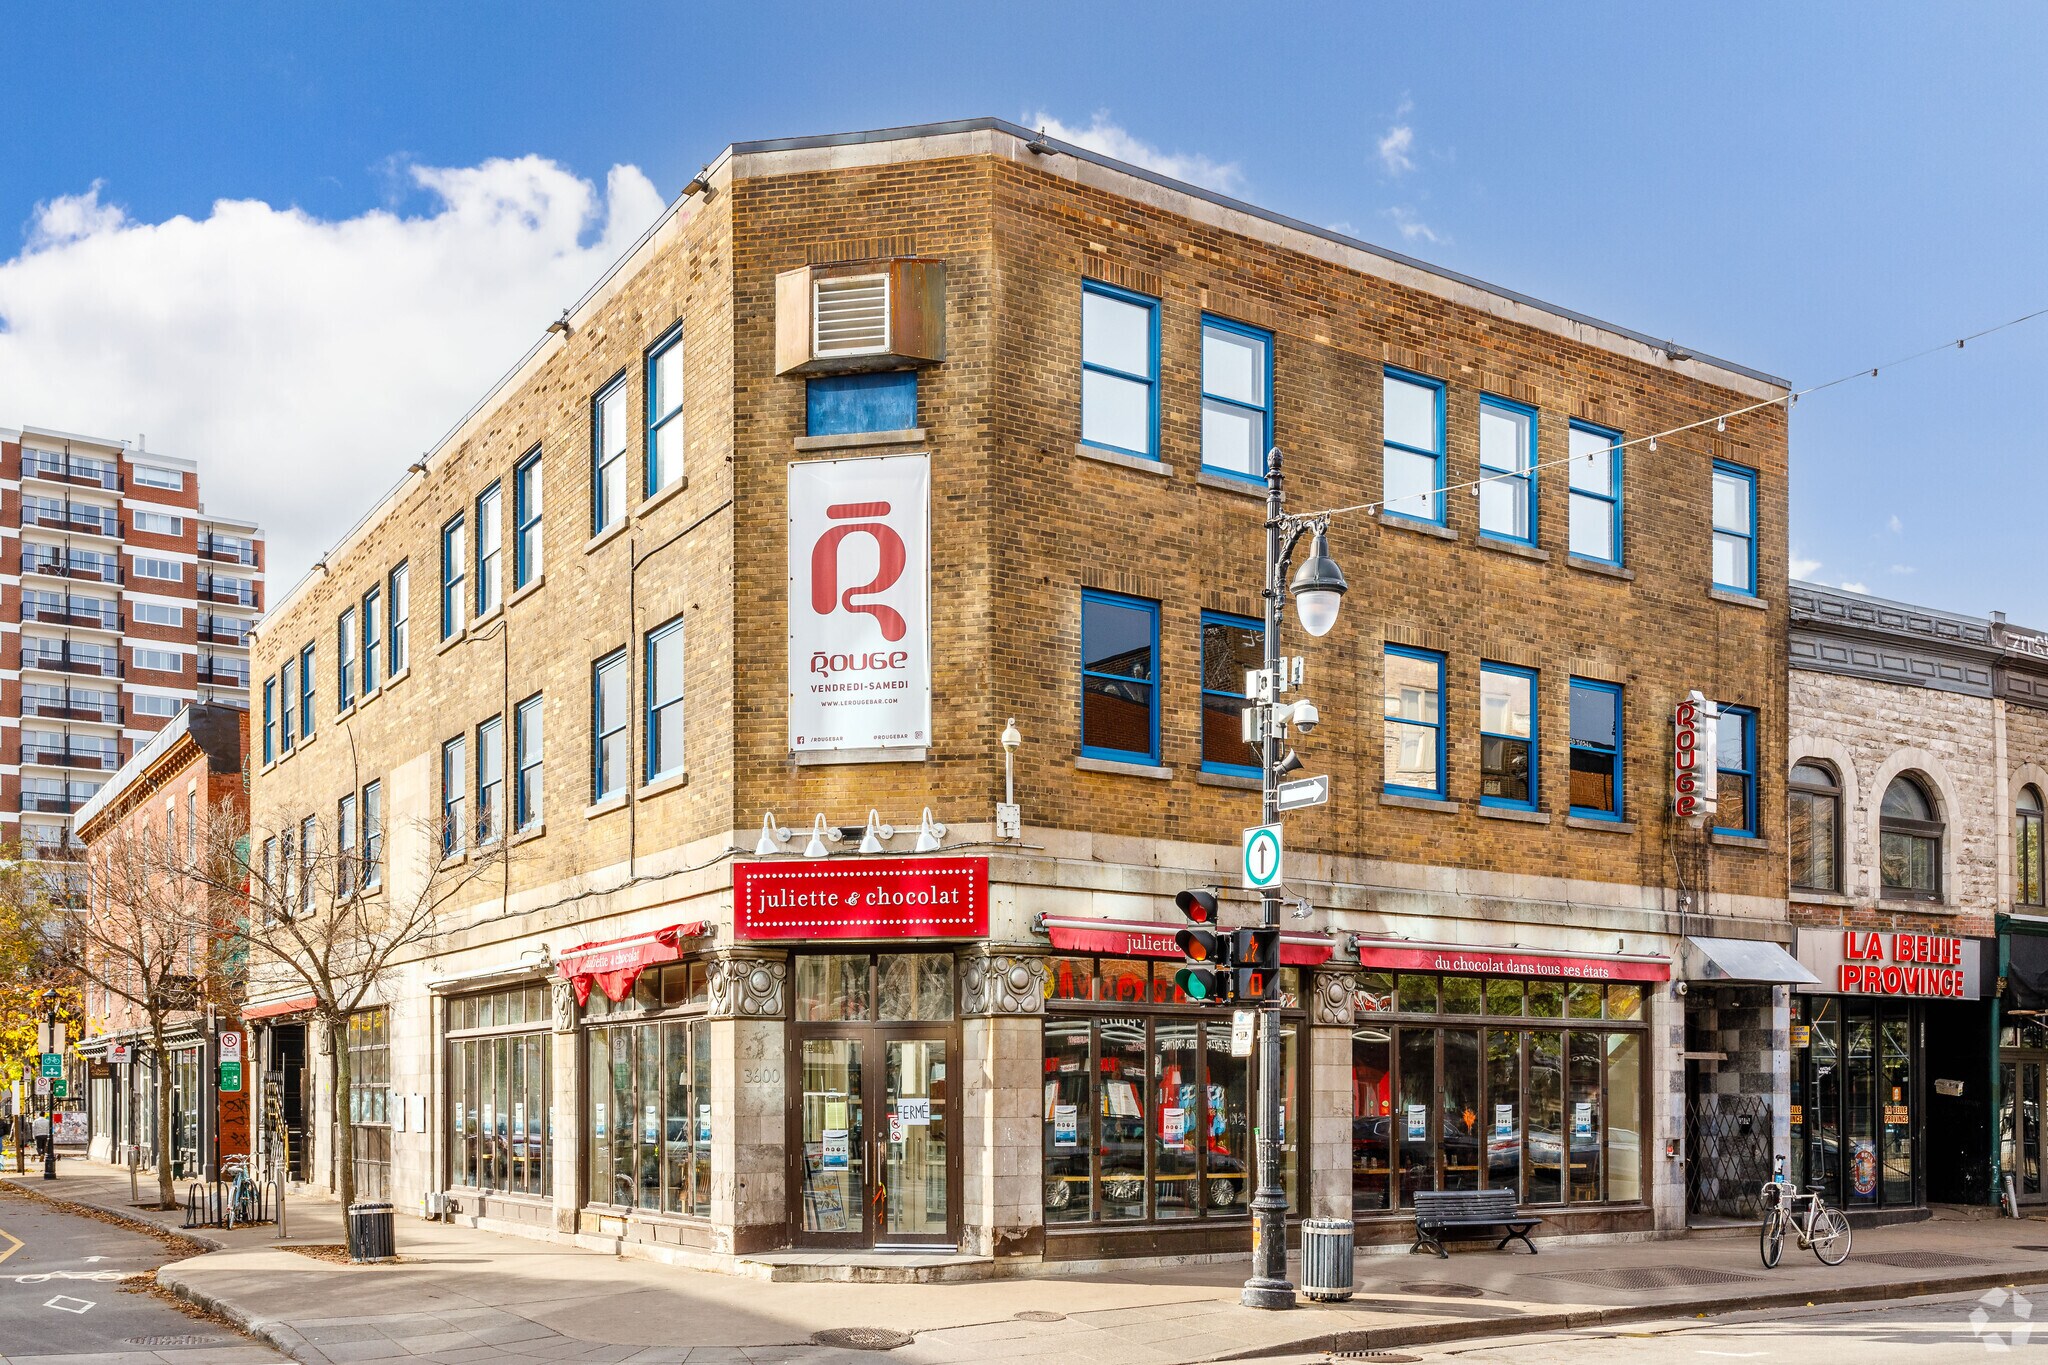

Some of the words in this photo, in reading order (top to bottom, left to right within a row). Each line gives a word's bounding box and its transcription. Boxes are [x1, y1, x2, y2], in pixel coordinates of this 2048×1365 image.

[811, 680, 909, 693] VENDREDI-SAMEDI
[821, 698, 898, 707] WWW.LEROUGEBAR.COM
[758, 888, 839, 914] juliette
[844, 891, 861, 906] &
[866, 885, 960, 907] chocolat
[1844, 931, 1884, 960] LA
[1893, 934, 1961, 965] BELLE
[1435, 955, 1450, 970] du
[1453, 956, 1504, 973] chocolat
[1507, 959, 1535, 974] dans
[1537, 963, 1560, 975] tous
[1563, 966, 1581, 977] ses
[1583, 964, 1609, 978] états
[1838, 964, 1965, 997] PROVINCE
[743, 1068, 781, 1084] 3600
[897, 1101, 930, 1120] FERMÉ
